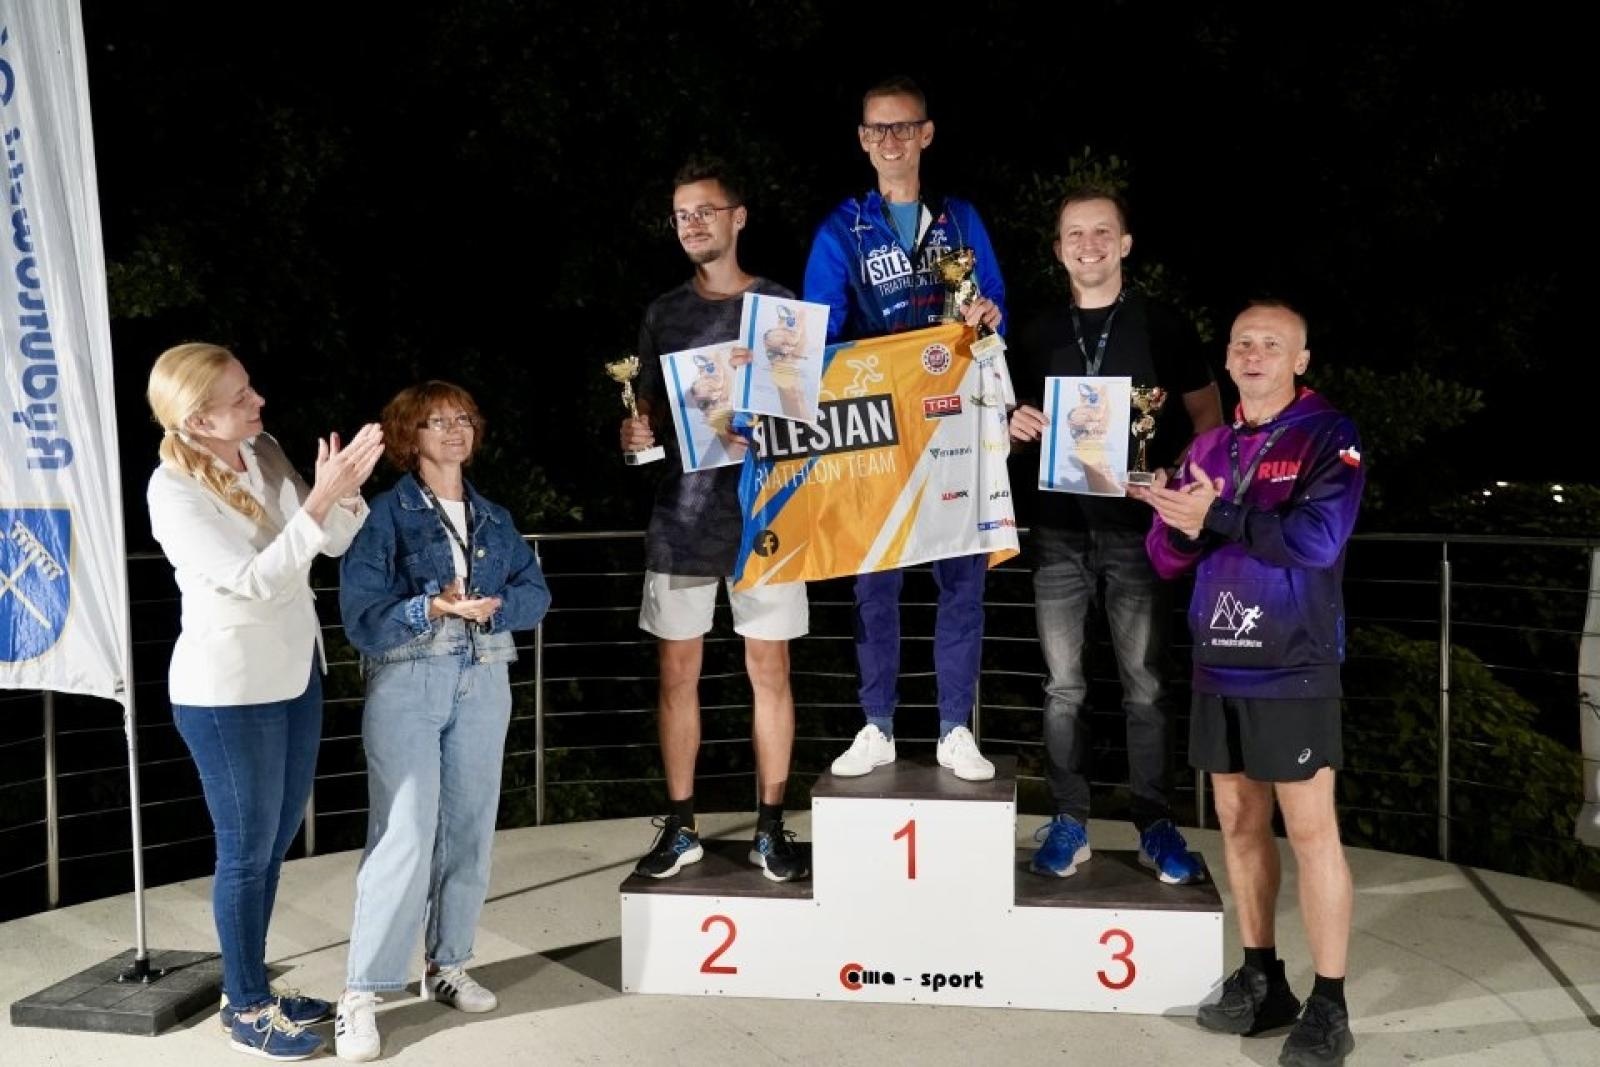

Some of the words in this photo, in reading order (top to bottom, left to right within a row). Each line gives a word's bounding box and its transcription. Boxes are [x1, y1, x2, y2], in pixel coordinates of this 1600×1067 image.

[754, 461, 841, 493] RIATHLON
[849, 449, 897, 480] TEAM
[1257, 461, 1300, 480] RUN
[892, 819, 916, 880] 1
[699, 914, 738, 975] 2
[1096, 928, 1137, 990] 3
[920, 970, 985, 993] sport
